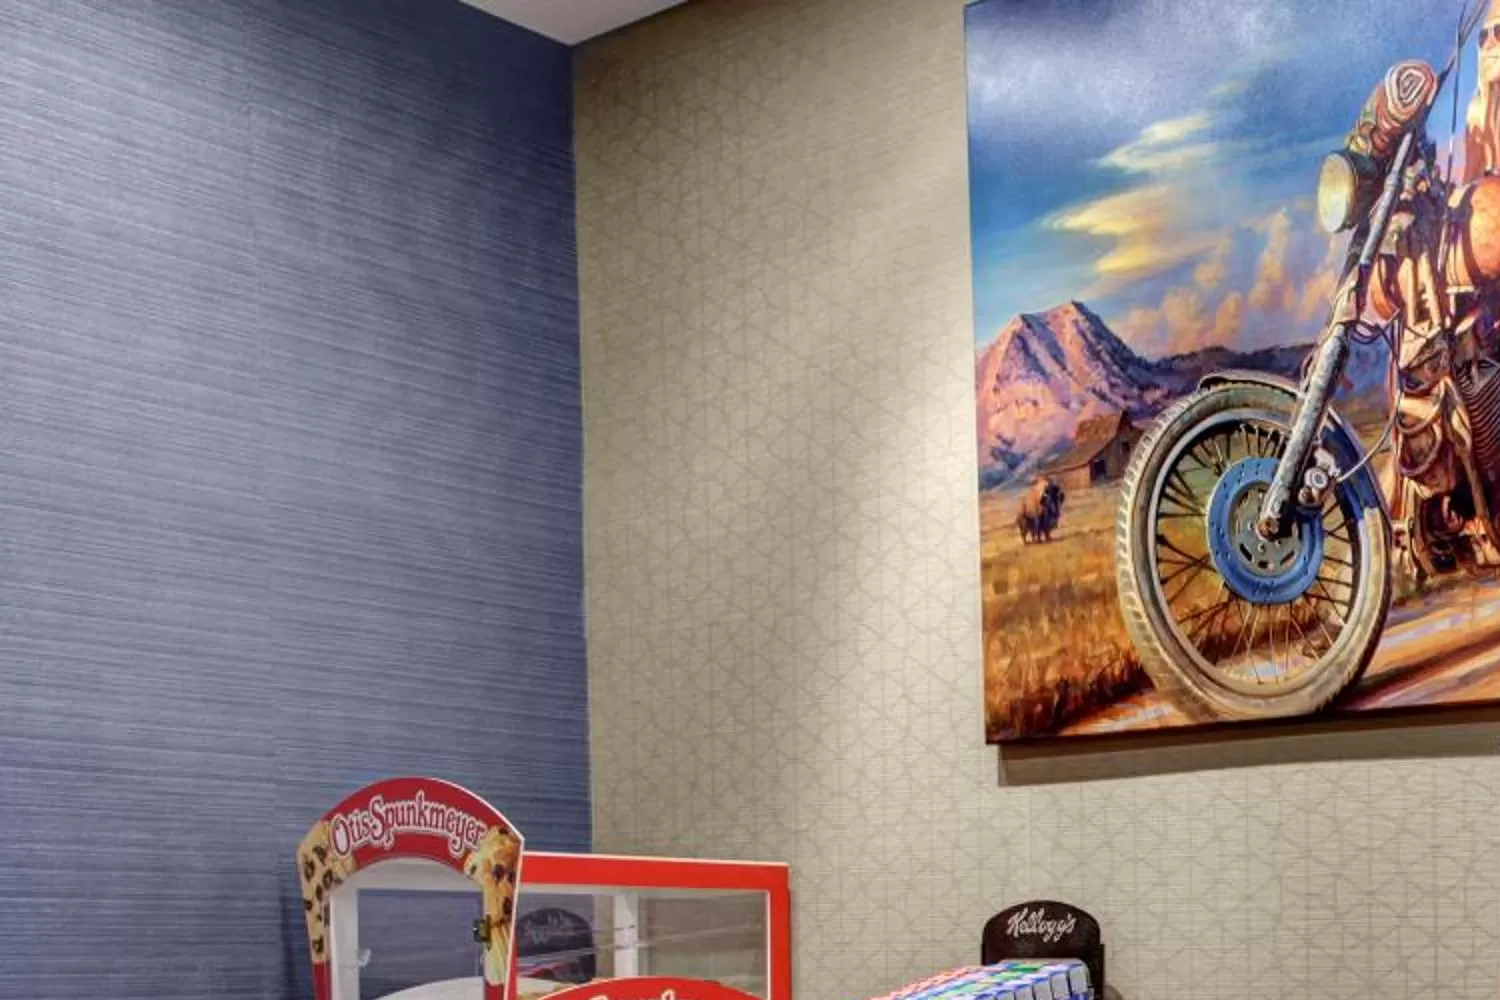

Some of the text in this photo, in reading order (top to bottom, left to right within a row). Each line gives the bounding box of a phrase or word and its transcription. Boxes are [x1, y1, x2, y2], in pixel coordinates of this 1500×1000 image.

[331, 791, 486, 856] Otis Spunkmeyer
[1005, 906, 1077, 943] Kellogg's
